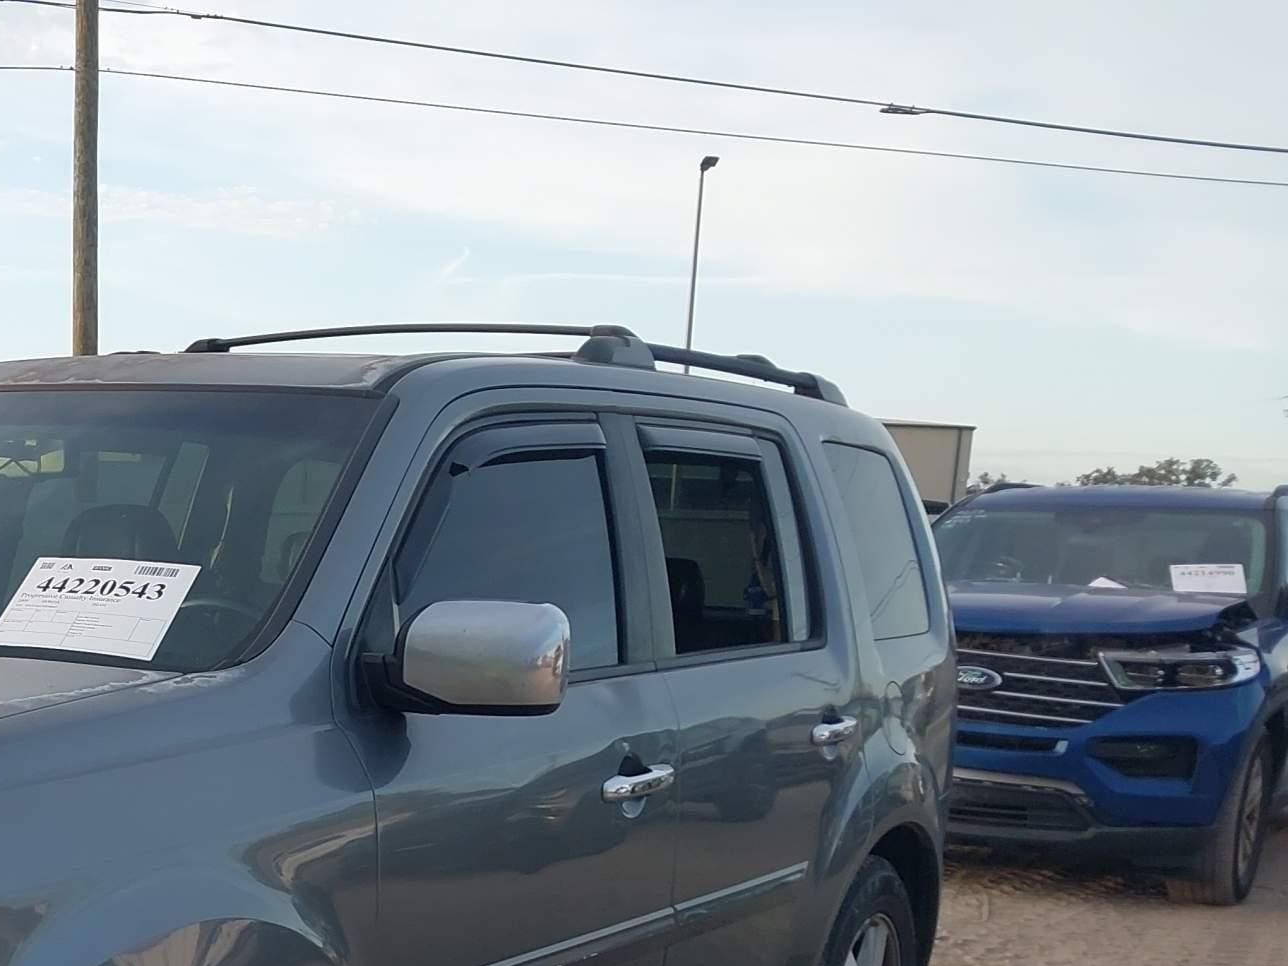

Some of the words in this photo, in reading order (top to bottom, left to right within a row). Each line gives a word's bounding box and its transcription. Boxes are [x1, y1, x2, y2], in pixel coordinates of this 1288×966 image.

[36, 576, 167, 601] 44220543
[60, 593, 87, 601] Casualty
[89, 595, 121, 603] Insurance
